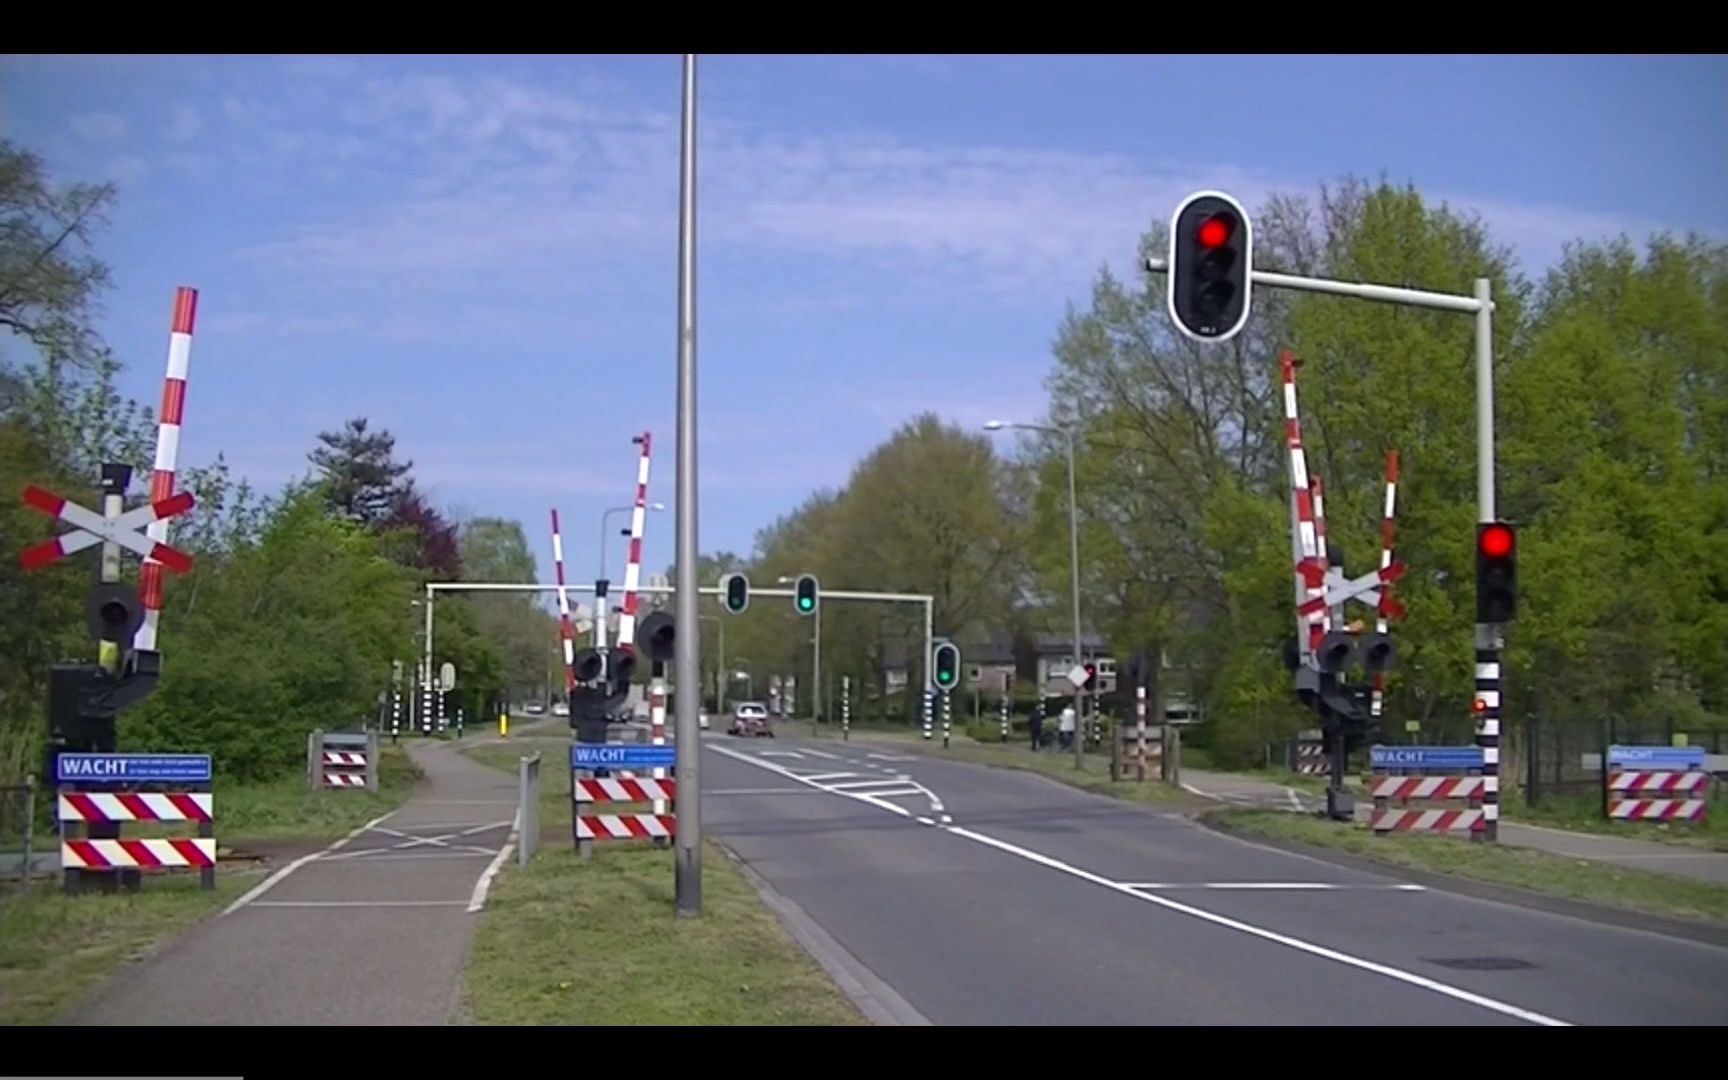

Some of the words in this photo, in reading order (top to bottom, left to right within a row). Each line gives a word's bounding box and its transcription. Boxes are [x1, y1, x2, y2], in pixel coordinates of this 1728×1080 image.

[576, 748, 626, 762] WACHT
[1374, 750, 1424, 762] WACHT
[63, 759, 128, 774] WACHT
